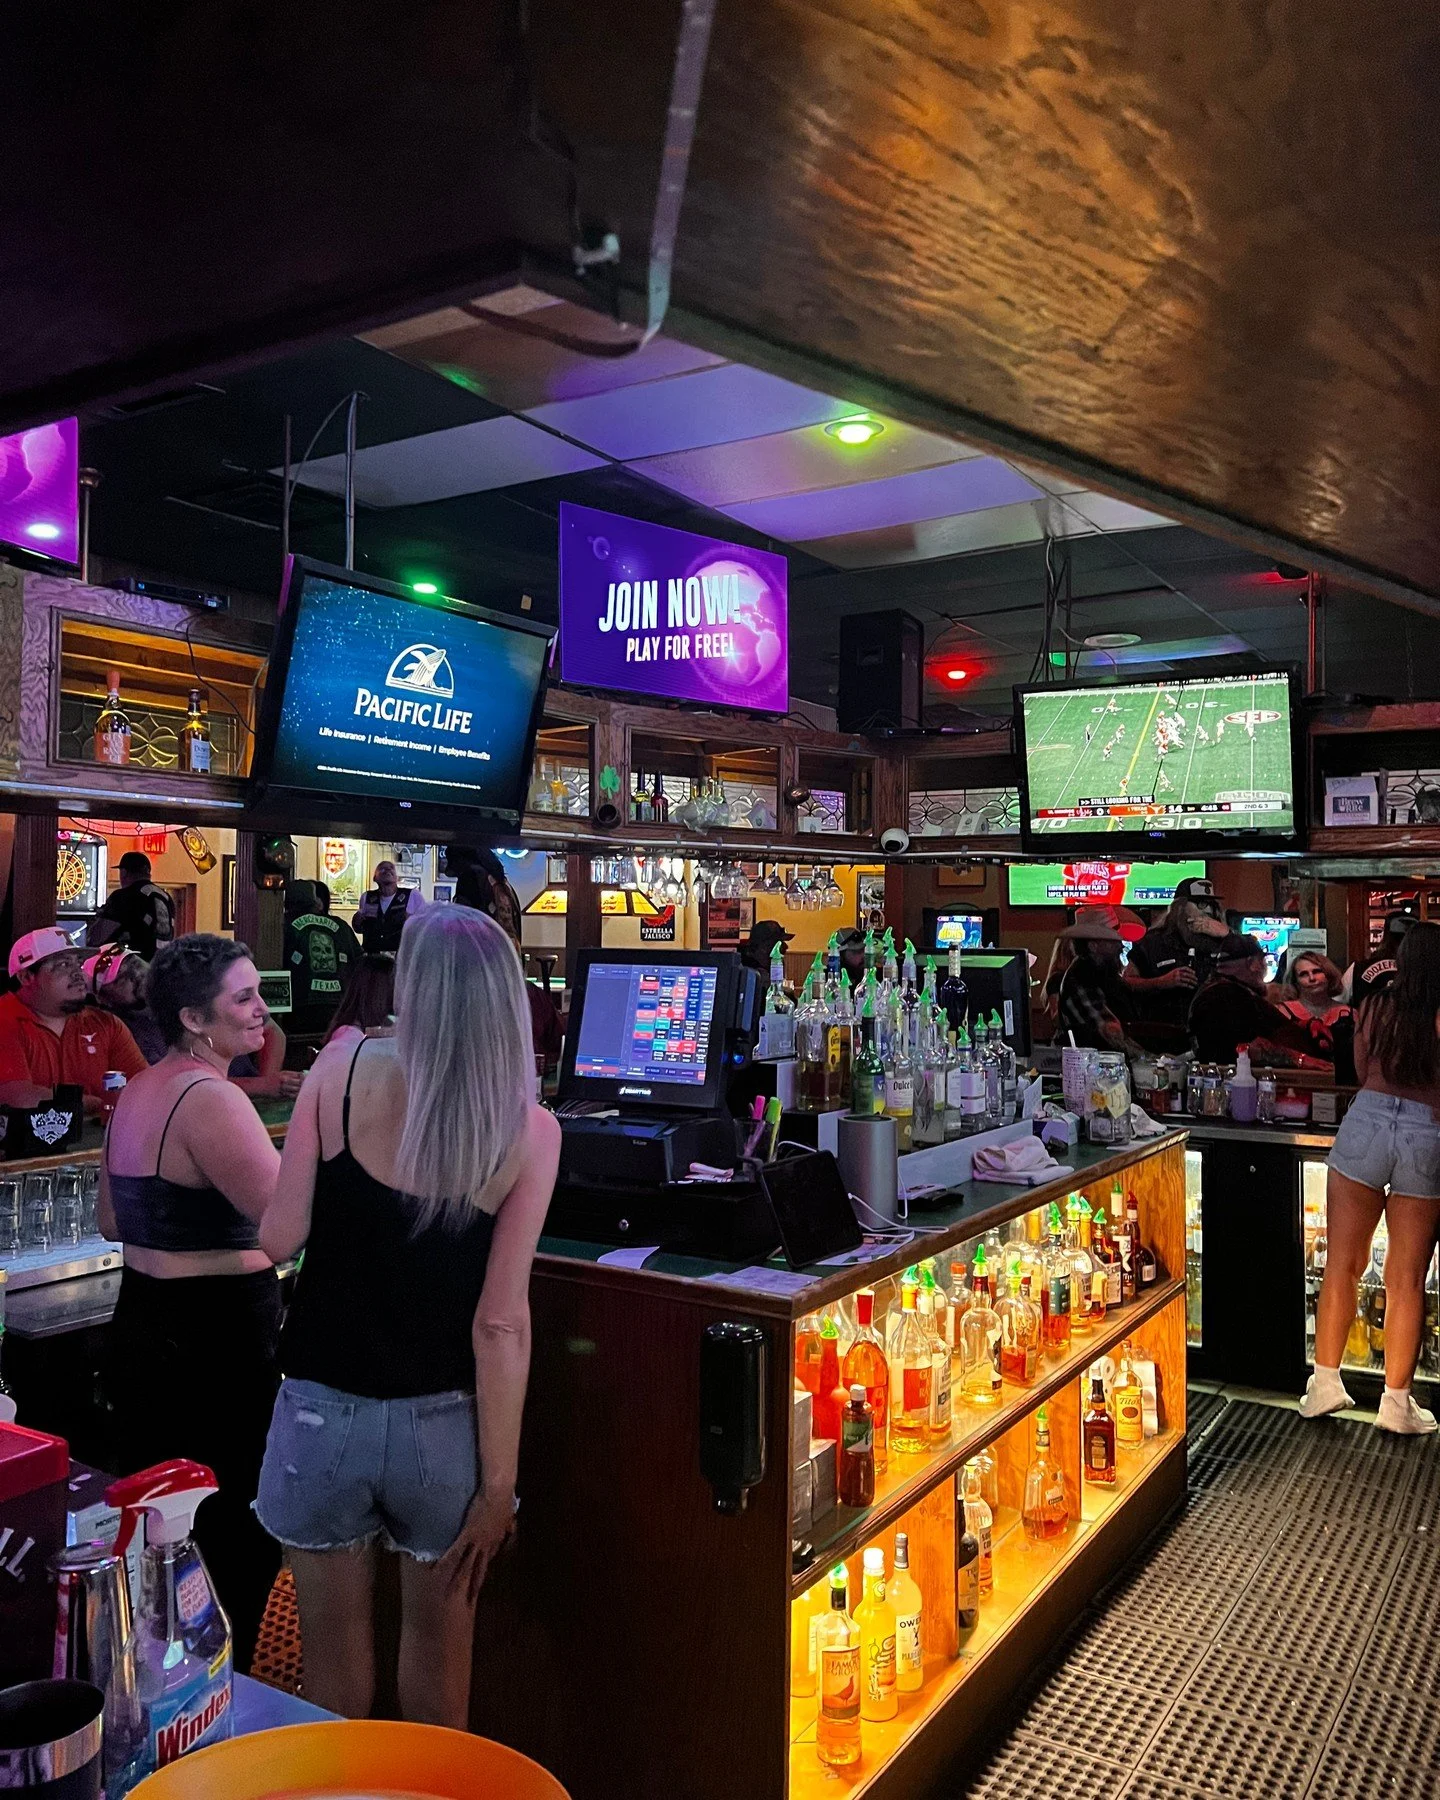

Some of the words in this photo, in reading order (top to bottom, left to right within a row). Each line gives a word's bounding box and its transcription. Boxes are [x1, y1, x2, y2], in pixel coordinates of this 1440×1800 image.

[598, 580, 658, 633] JOIN
[667, 574, 742, 628] NOW!
[626, 636, 661, 662] PLAY
[664, 634, 690, 661] FOR
[695, 632, 734, 659] FREE!
[353, 687, 432, 727] PACIFIC
[431, 702, 473, 734] LIFE
[319, 726, 333, 737] Life
[333, 730, 366, 742] Insurance
[373, 735, 409, 748] Retirement
[409, 740, 432, 752] Income
[438, 745, 467, 758] Employee
[467, 750, 491, 761] Benefits
[1096, 807, 1105, 816] 0
[294, 914, 338, 931] MERCENARIES
[313, 980, 340, 990] TEXAS
